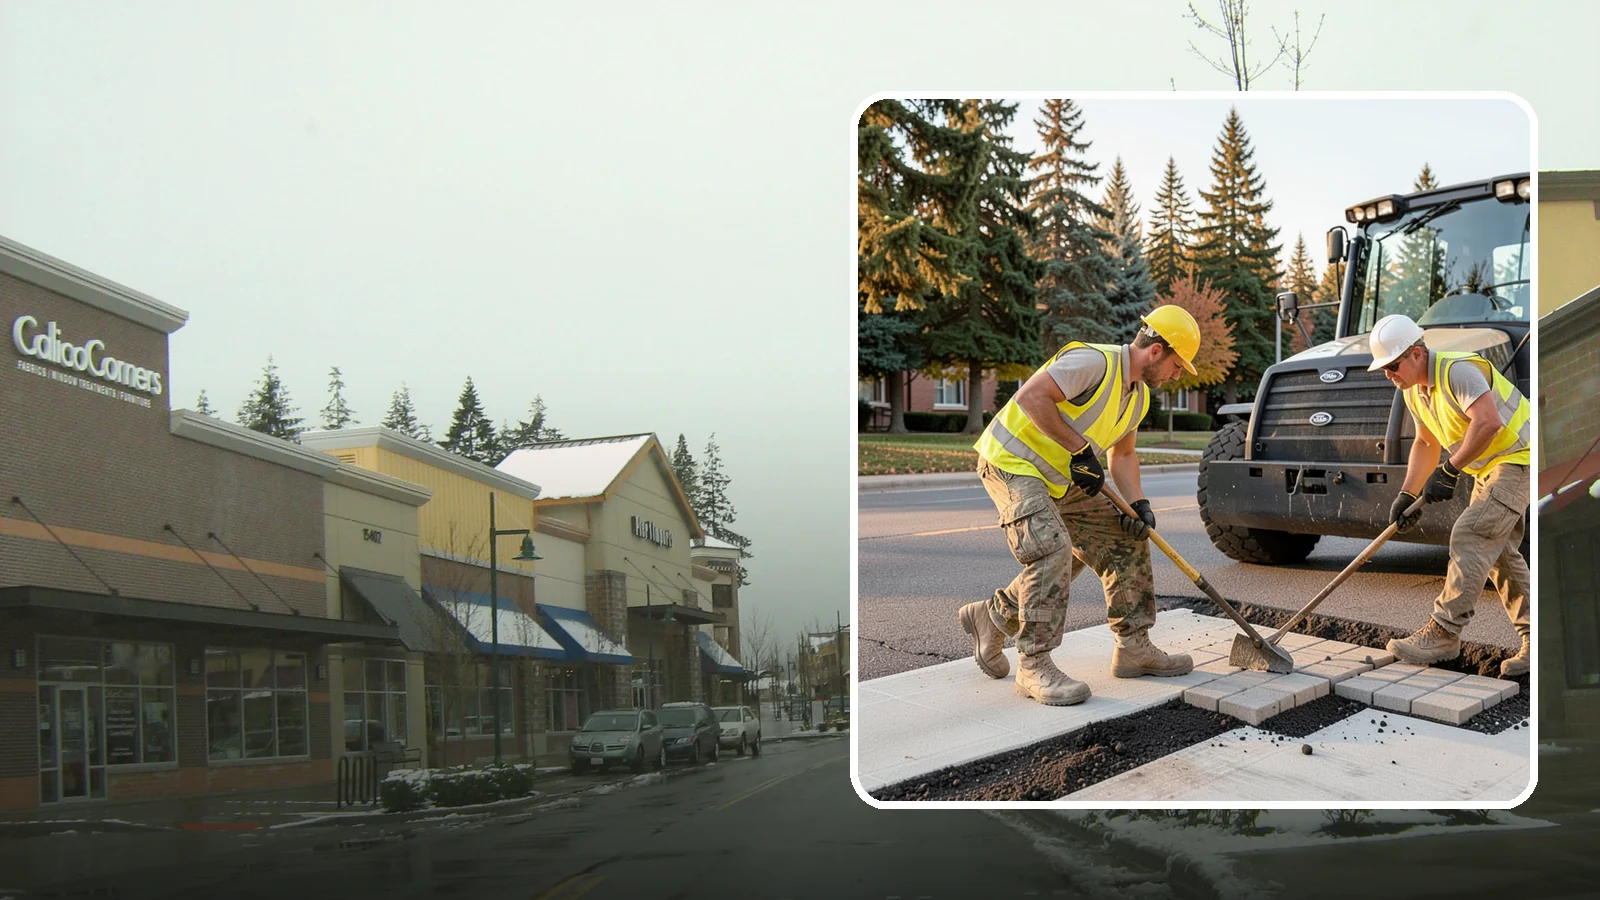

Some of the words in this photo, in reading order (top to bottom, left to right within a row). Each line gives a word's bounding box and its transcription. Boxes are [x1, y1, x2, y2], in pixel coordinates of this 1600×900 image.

[12, 315, 162, 395] CalicoCorners
[17, 360, 47, 377] FABRICS
[51, 370, 79, 387] WINDOW
[78, 378, 117, 398] TREATMENTS
[119, 391, 151, 409] FURNITURE
